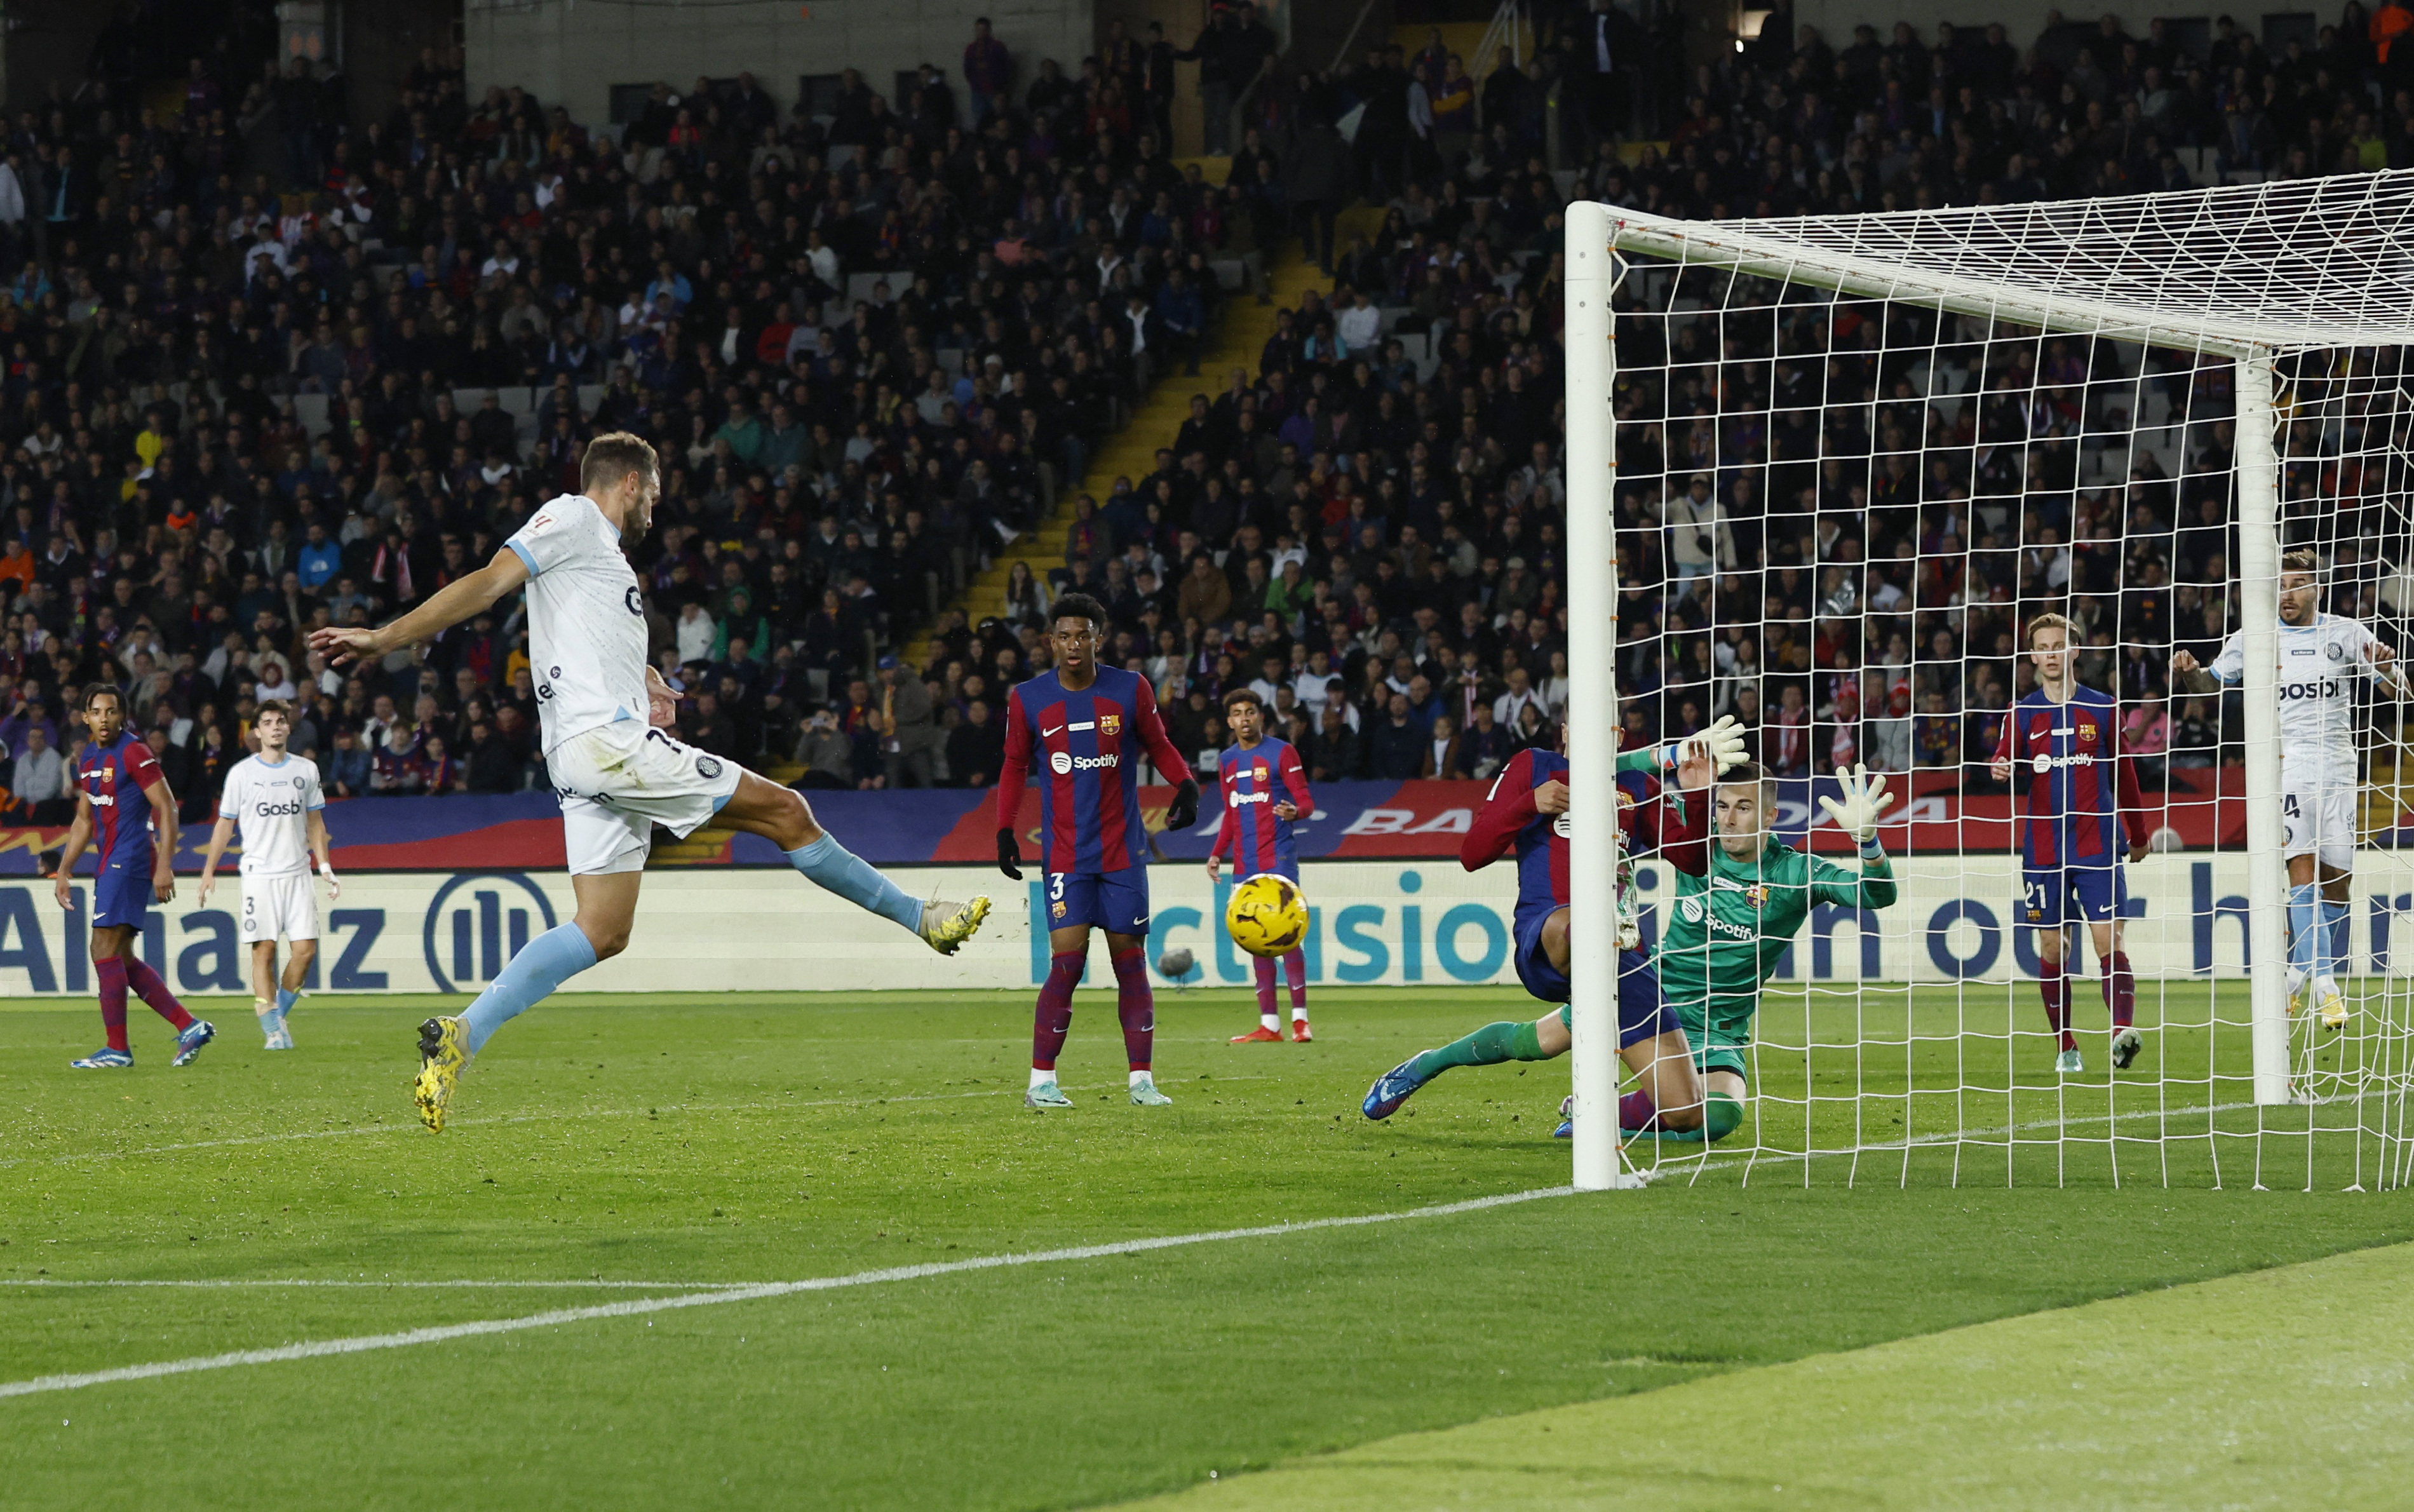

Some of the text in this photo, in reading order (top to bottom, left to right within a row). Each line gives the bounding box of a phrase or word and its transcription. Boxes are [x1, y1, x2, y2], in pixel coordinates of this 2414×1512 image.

[1074, 753, 1119, 770] Spotify
[2052, 753, 2094, 768] Spotify
[1238, 791, 1269, 804] Spotify
[1049, 872, 1065, 900] 3
[2025, 881, 2047, 909] 21
[246, 896, 255, 915] 3
[0, 886, 389, 992] Aliaz
[1704, 913, 1758, 942] Spotify
